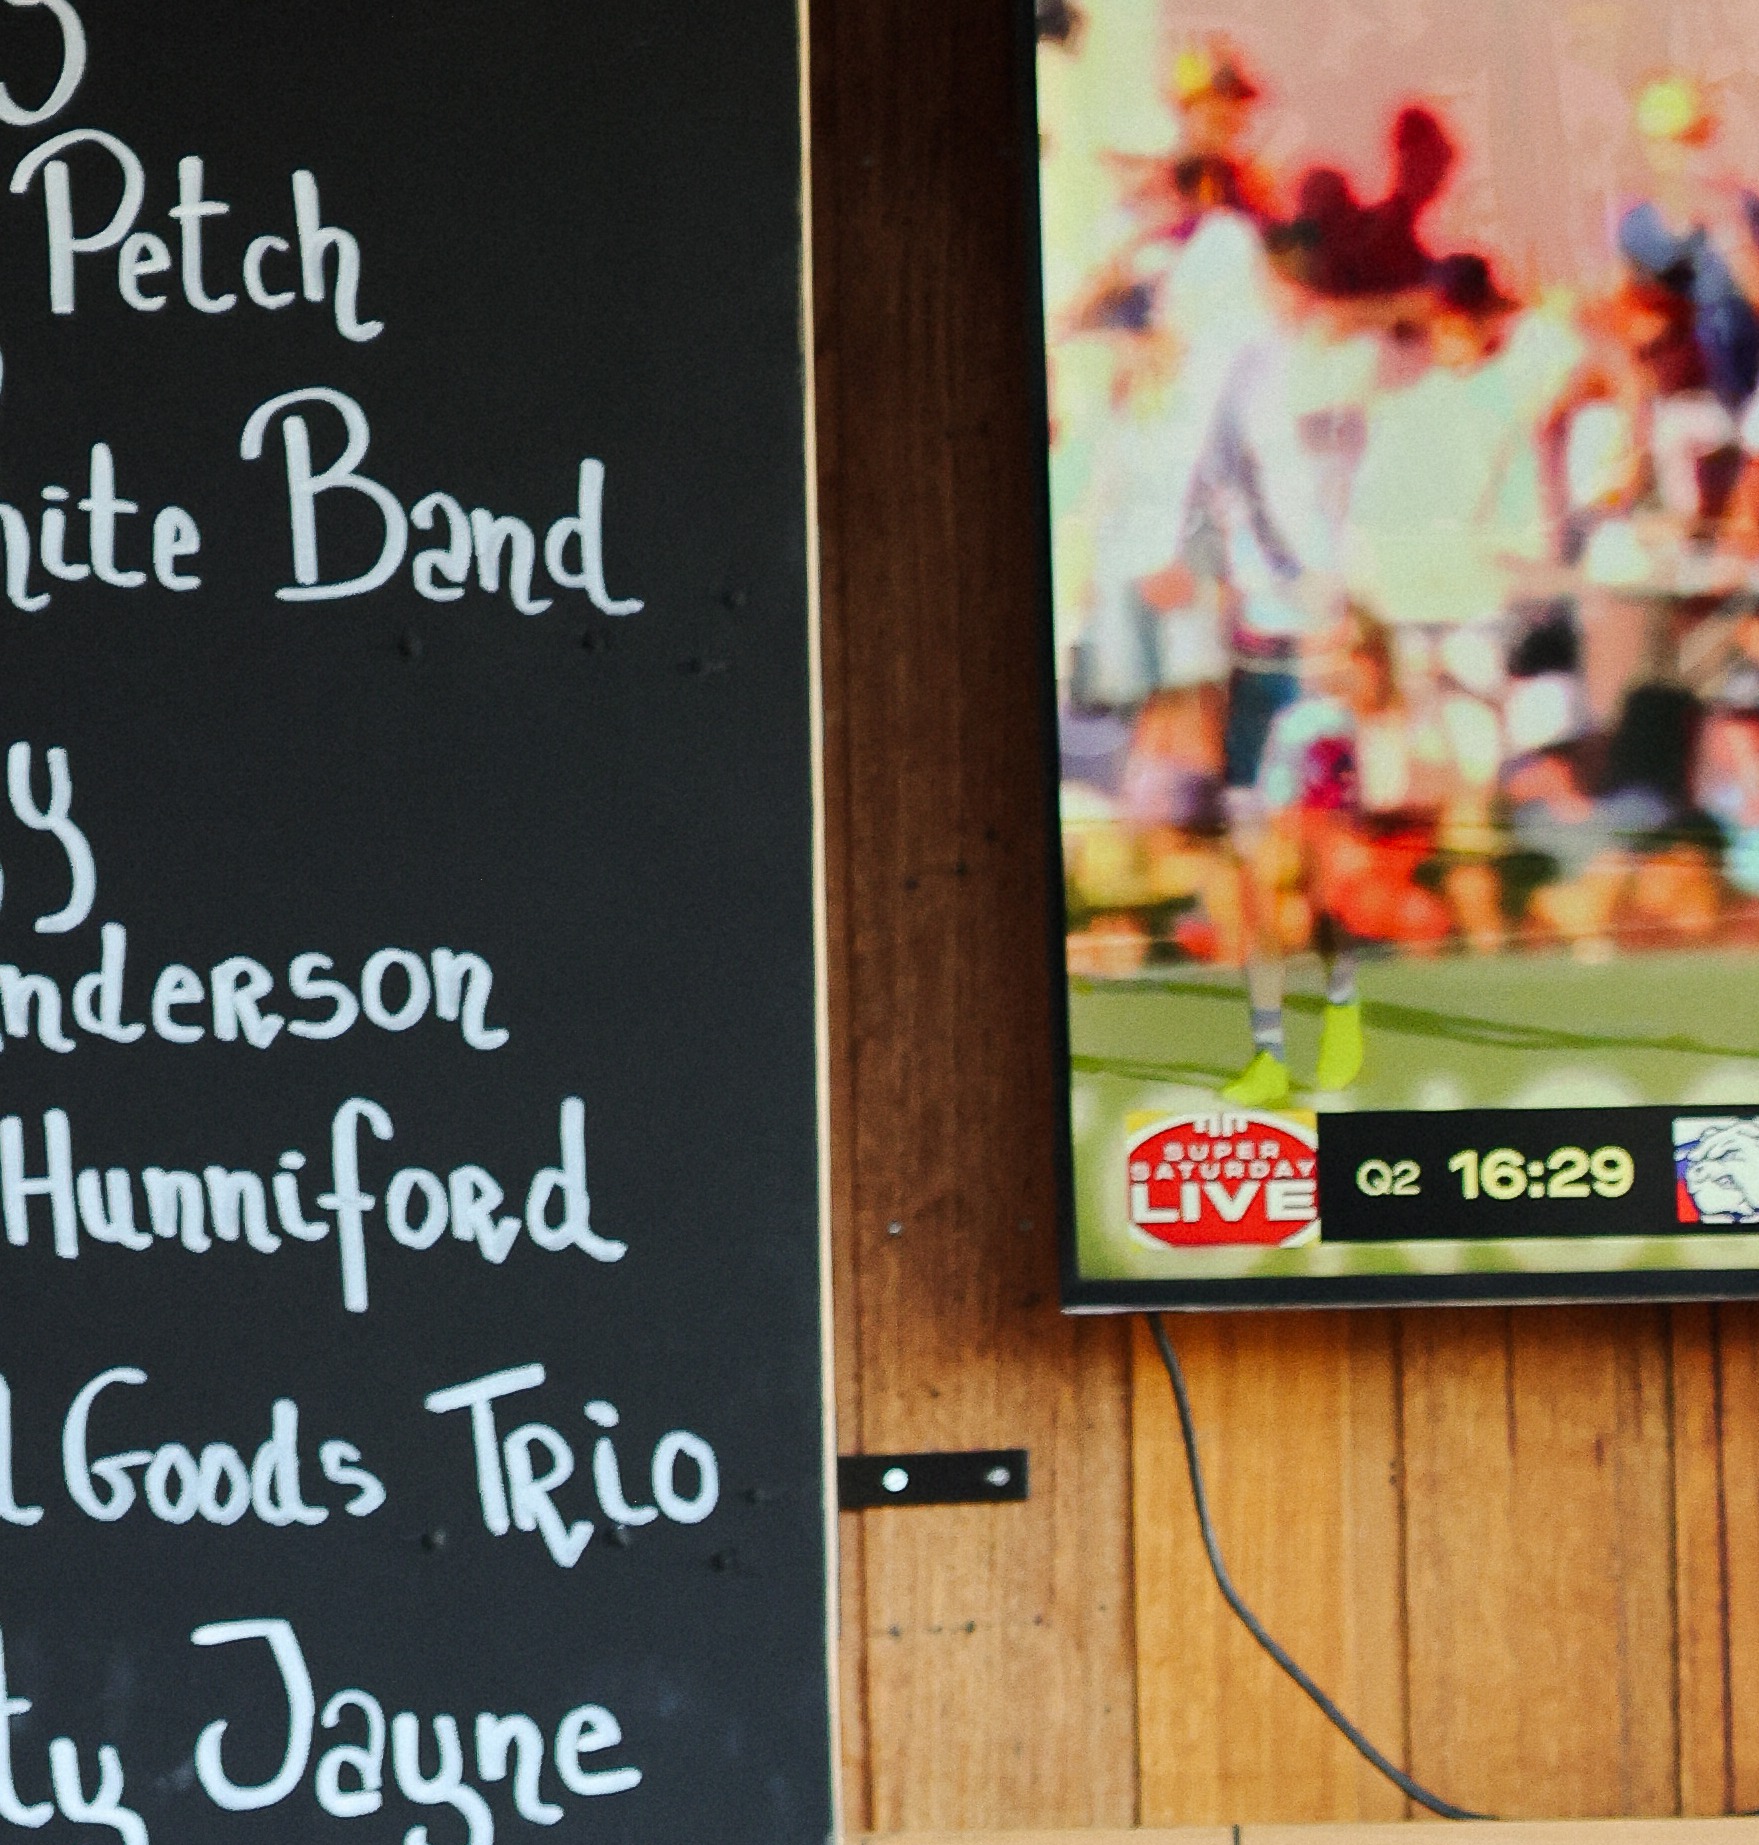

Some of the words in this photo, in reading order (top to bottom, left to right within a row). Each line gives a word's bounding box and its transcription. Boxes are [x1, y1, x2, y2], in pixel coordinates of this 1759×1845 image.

[10, 128, 384, 341] Petch
[241, 387, 645, 616] Band
[1129, 1158, 1316, 1182] SATURDAY
[1162, 1140, 1281, 1163] SUPER
[1356, 1158, 1422, 1197] Q2
[1447, 1144, 1636, 1200] 16:29
[1130, 1177, 1317, 1224] LIVE
[63, 1365, 386, 1526] Goods
